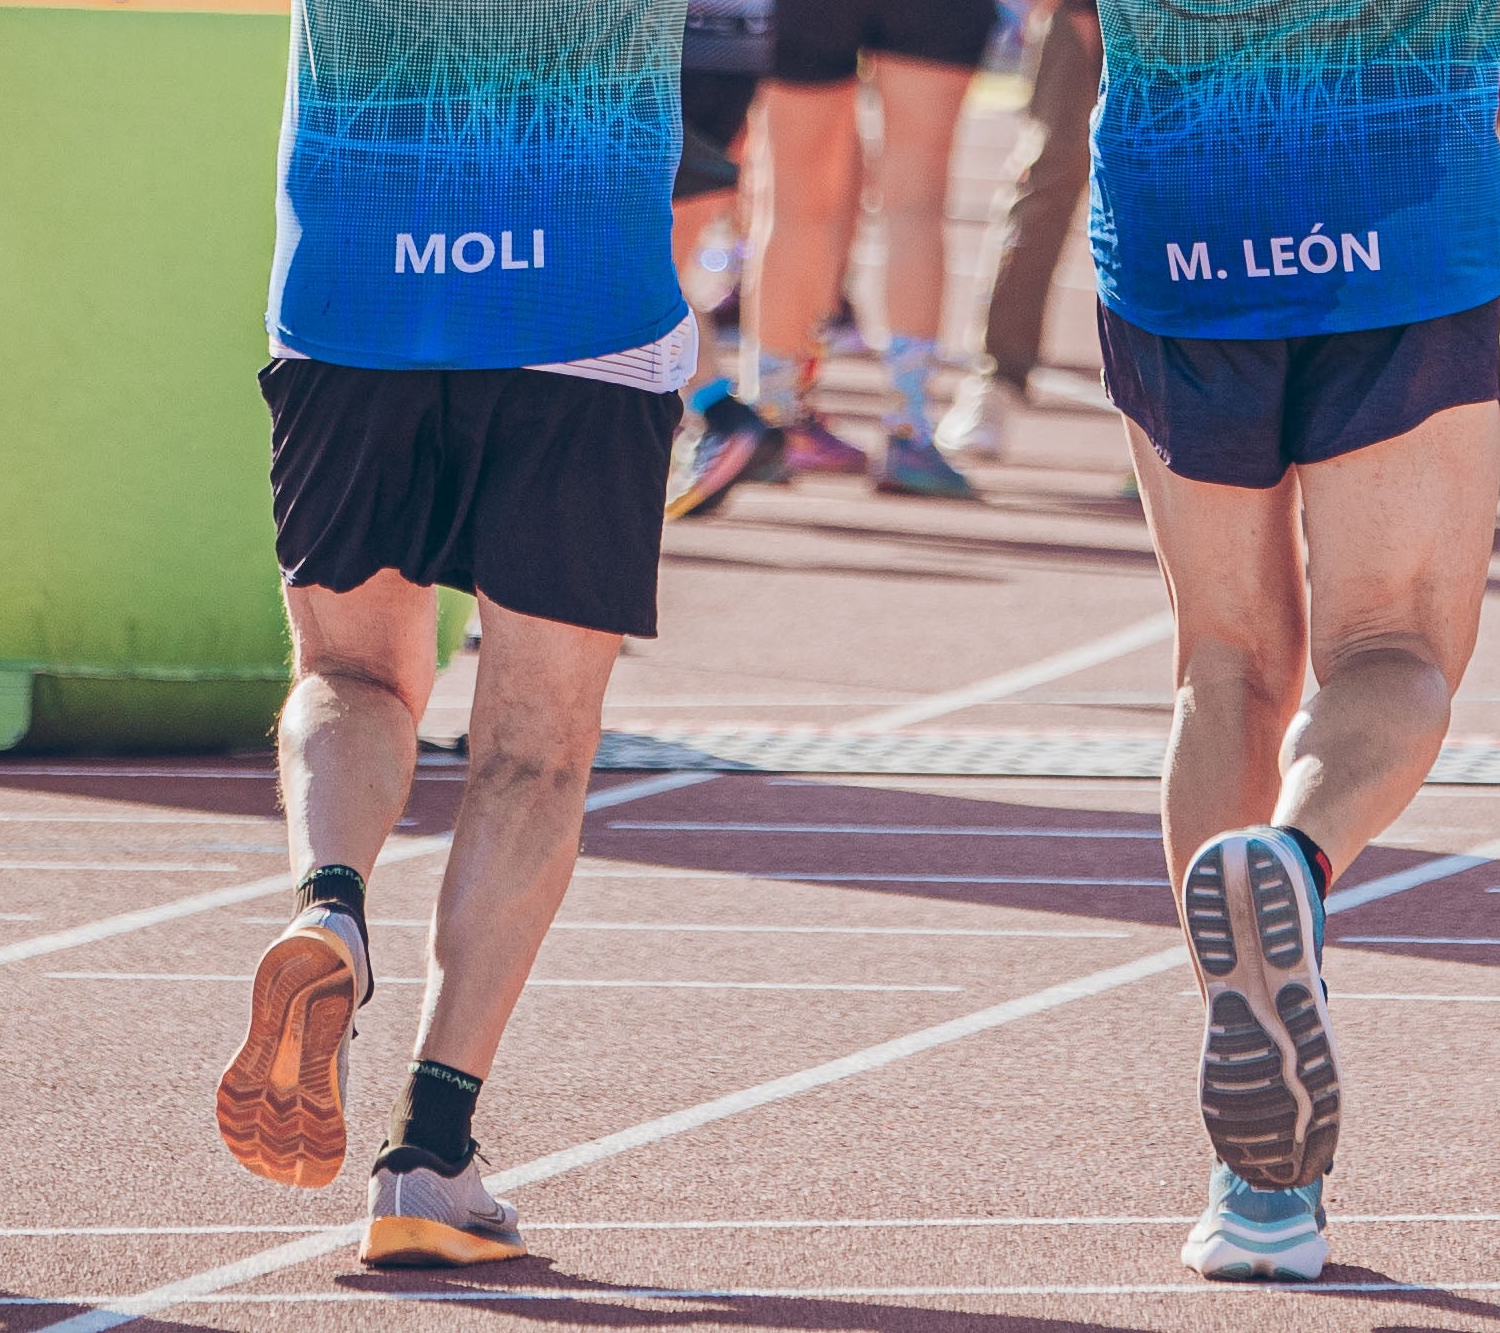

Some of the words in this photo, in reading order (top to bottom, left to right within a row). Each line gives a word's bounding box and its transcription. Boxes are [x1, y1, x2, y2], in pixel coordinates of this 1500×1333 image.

[395, 229, 545, 274] MOLI
[1166, 241, 1228, 282] M.
[1243, 222, 1381, 278] LEÓN
